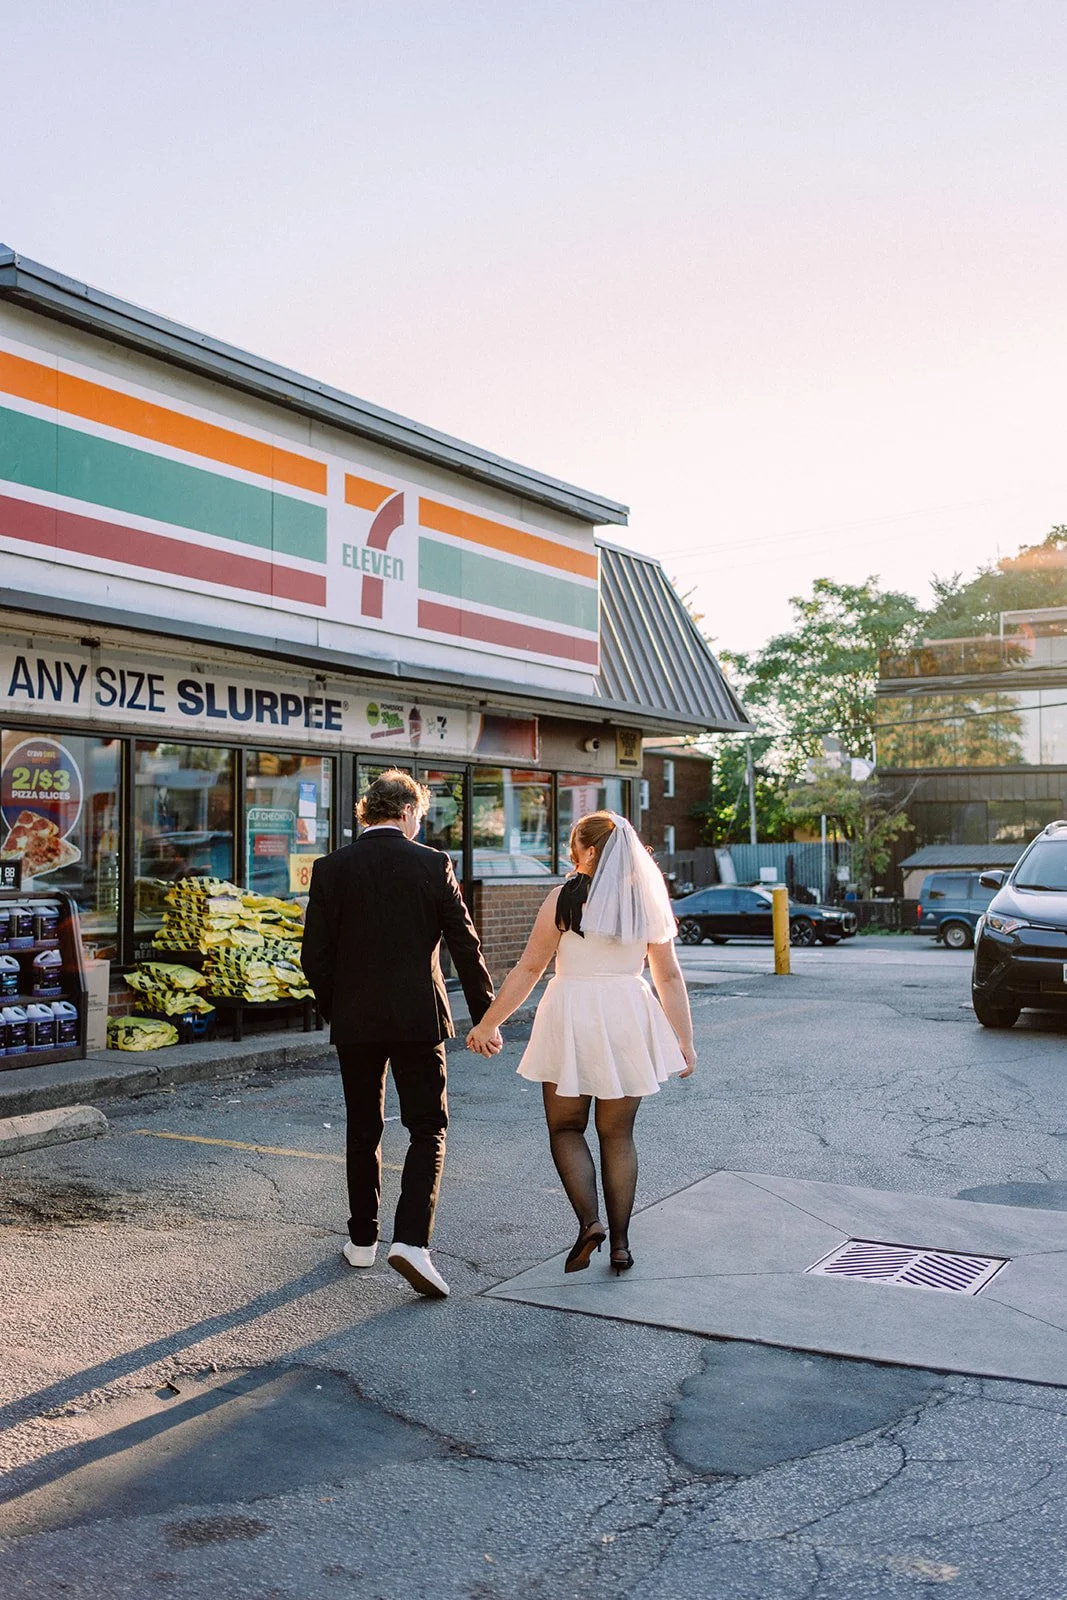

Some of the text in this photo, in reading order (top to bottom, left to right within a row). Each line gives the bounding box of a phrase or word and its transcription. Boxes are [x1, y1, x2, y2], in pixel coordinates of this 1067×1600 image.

[8, 656, 87, 703] ANY
[95, 666, 166, 713] SIZE
[12, 767, 70, 791] 2/$3
[11, 790, 71, 800] PIZZA SLICES
